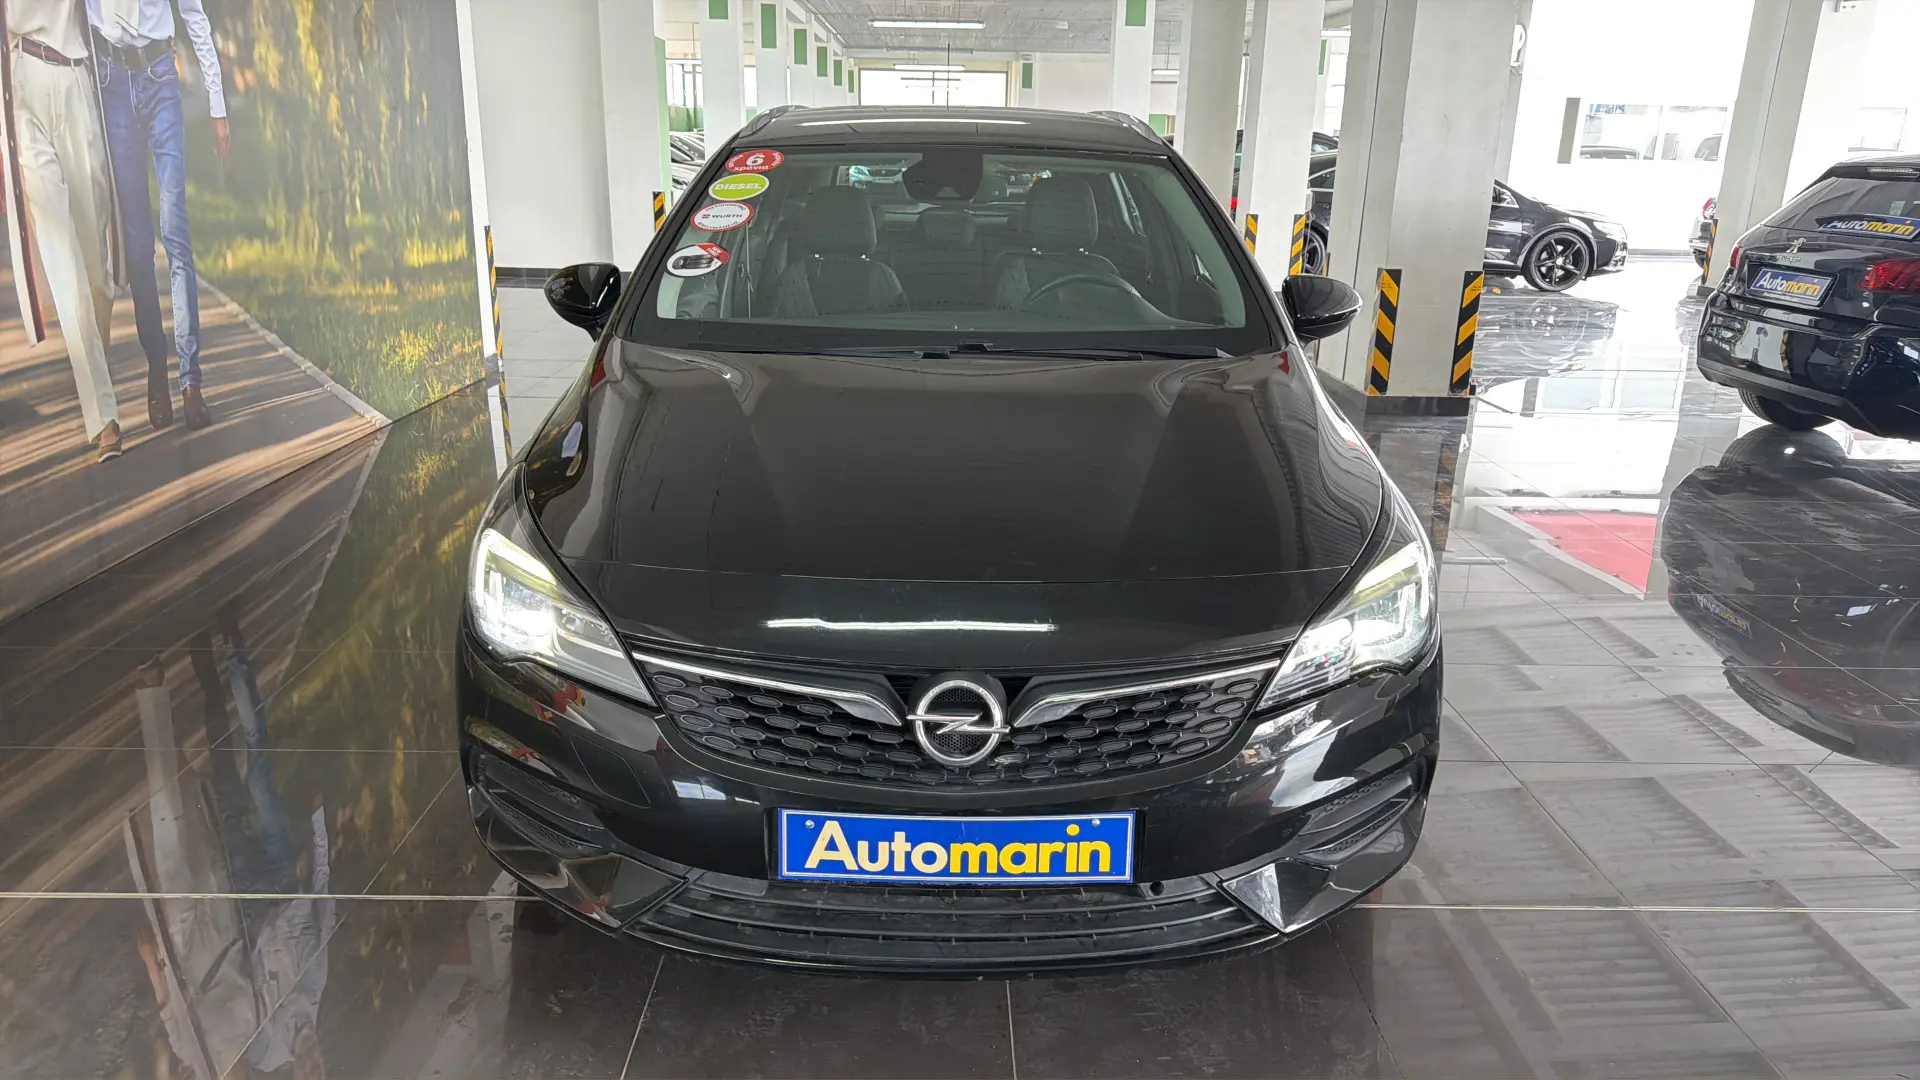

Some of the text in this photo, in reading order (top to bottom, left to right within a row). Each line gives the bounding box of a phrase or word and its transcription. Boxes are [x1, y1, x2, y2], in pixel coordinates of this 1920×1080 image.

[746, 155, 766, 166] 6
[715, 183, 761, 191] DIESEL
[1756, 271, 1821, 297] Automarin
[804, 820, 1111, 874] Automarin
